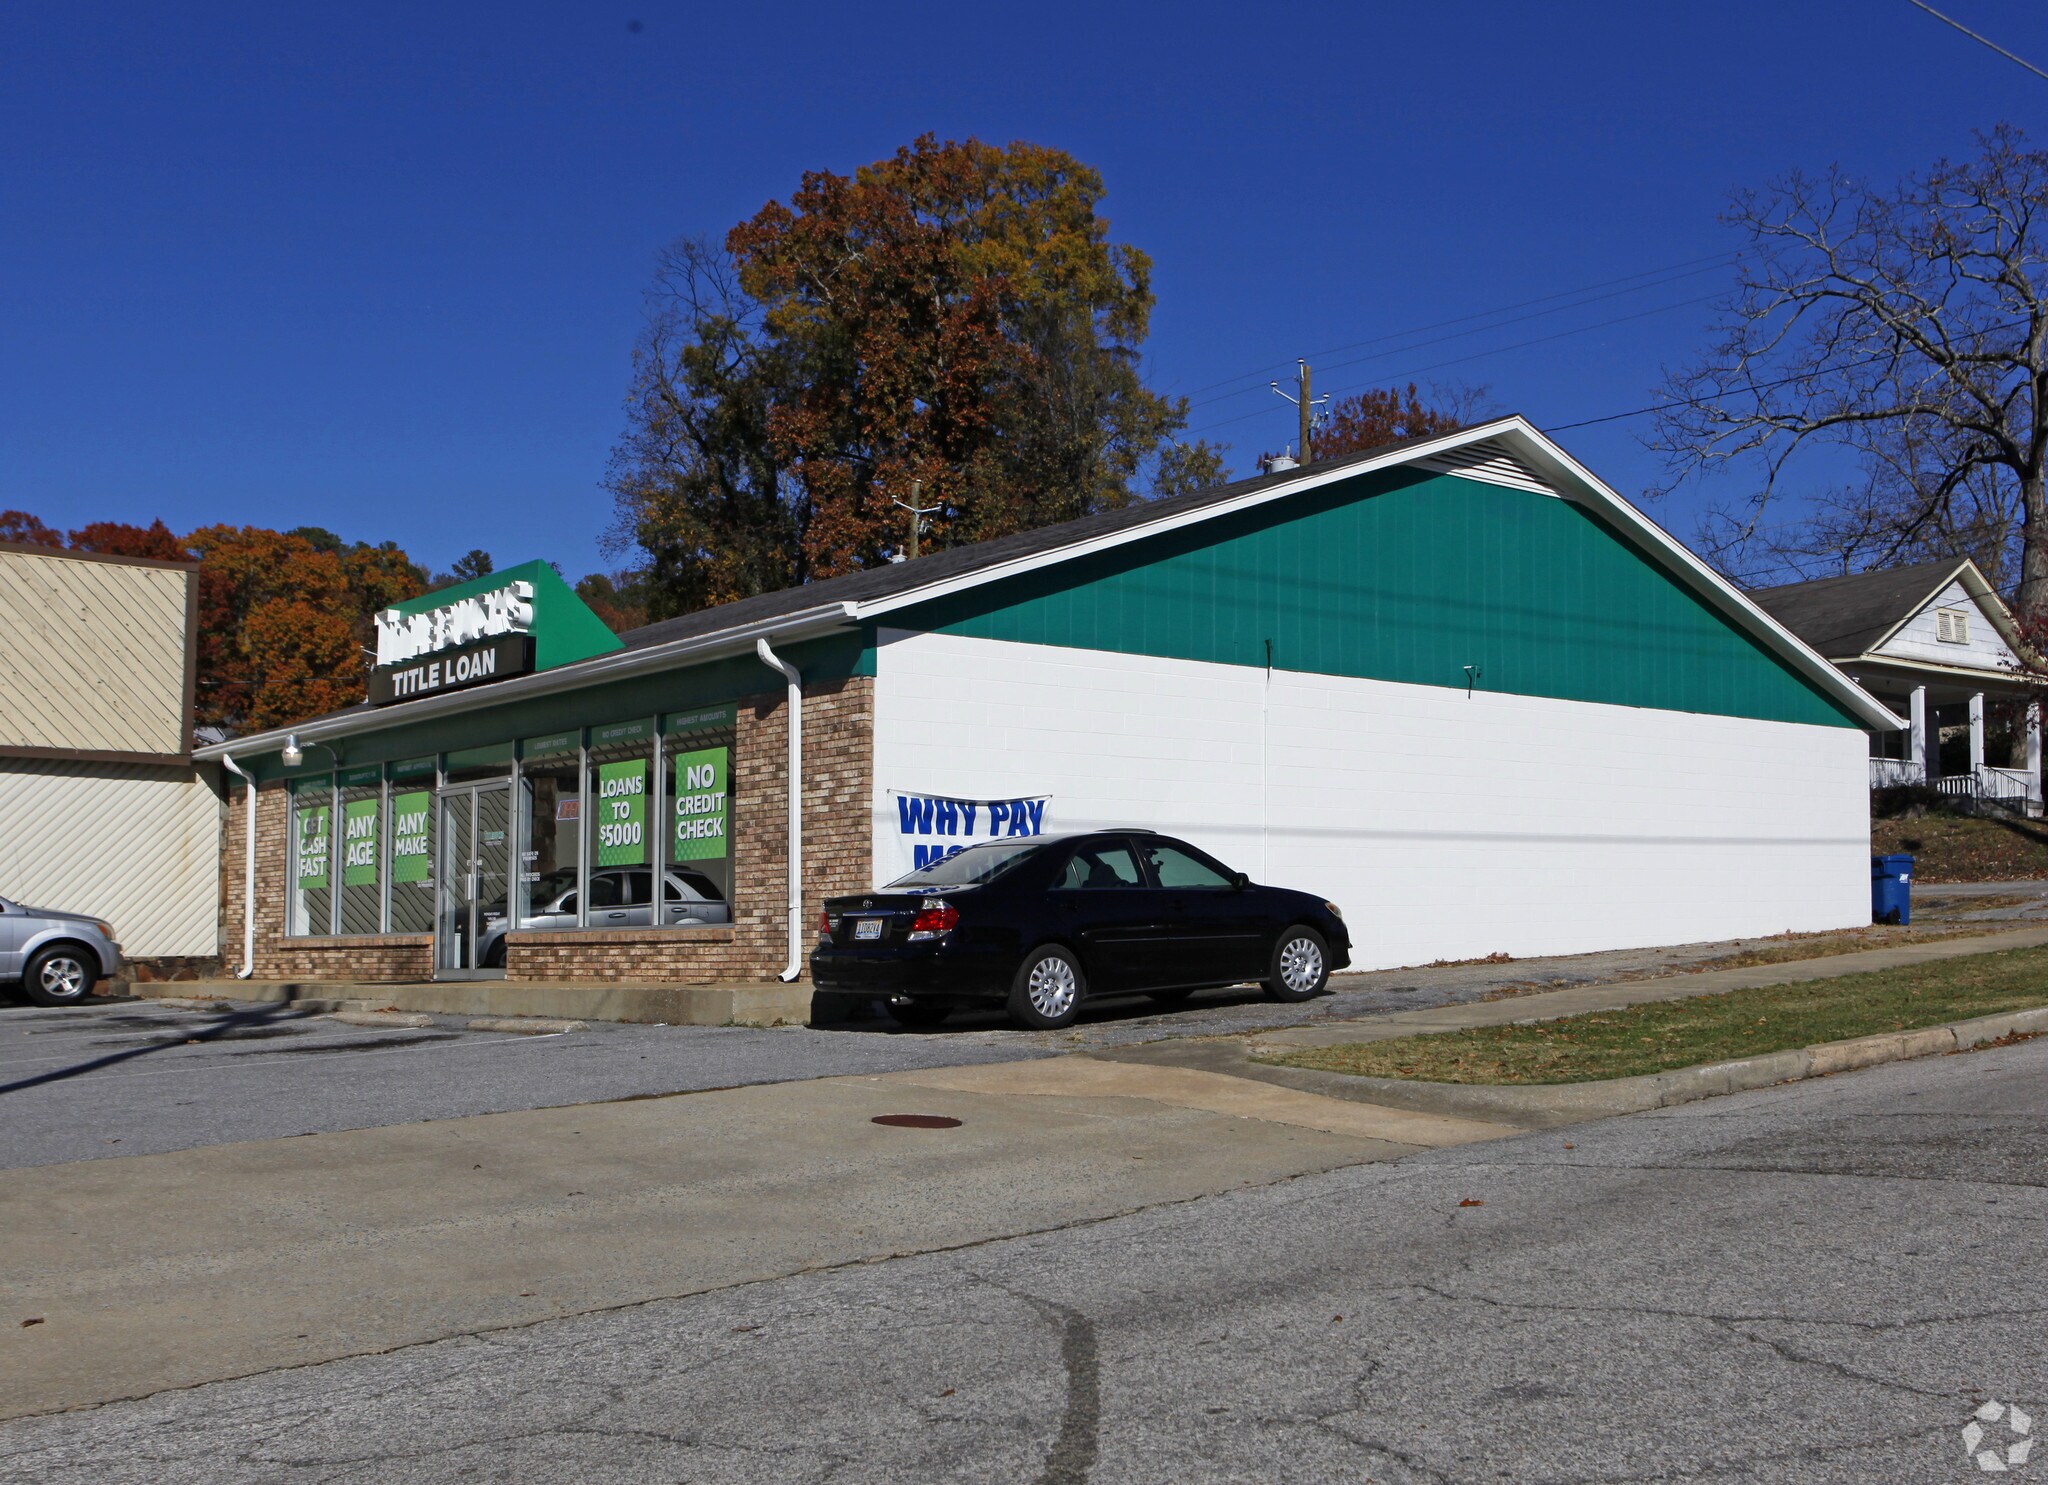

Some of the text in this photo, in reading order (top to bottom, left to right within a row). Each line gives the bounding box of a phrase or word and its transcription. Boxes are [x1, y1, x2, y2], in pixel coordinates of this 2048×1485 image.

[392, 647, 496, 697] TITLE LOAN
[699, 710, 727, 722] AMOUNTS
[610, 728, 626, 737] CREDIT
[627, 725, 643, 735] CHECK
[600, 775, 643, 799] LOANS
[687, 763, 715, 790] NO
[611, 801, 630, 820] TO
[676, 791, 725, 816] CREDIT
[304, 816, 324, 834] GET
[347, 815, 377, 840] ANY
[397, 812, 427, 836] ANY
[677, 816, 724, 840] CHECK
[897, 796, 1046, 837] WHY PAY
[300, 836, 327, 855] CASH
[600, 821, 642, 847] $5000
[347, 841, 374, 867] AGE
[396, 836, 428, 857] MAKE
[299, 856, 327, 878] FAST
